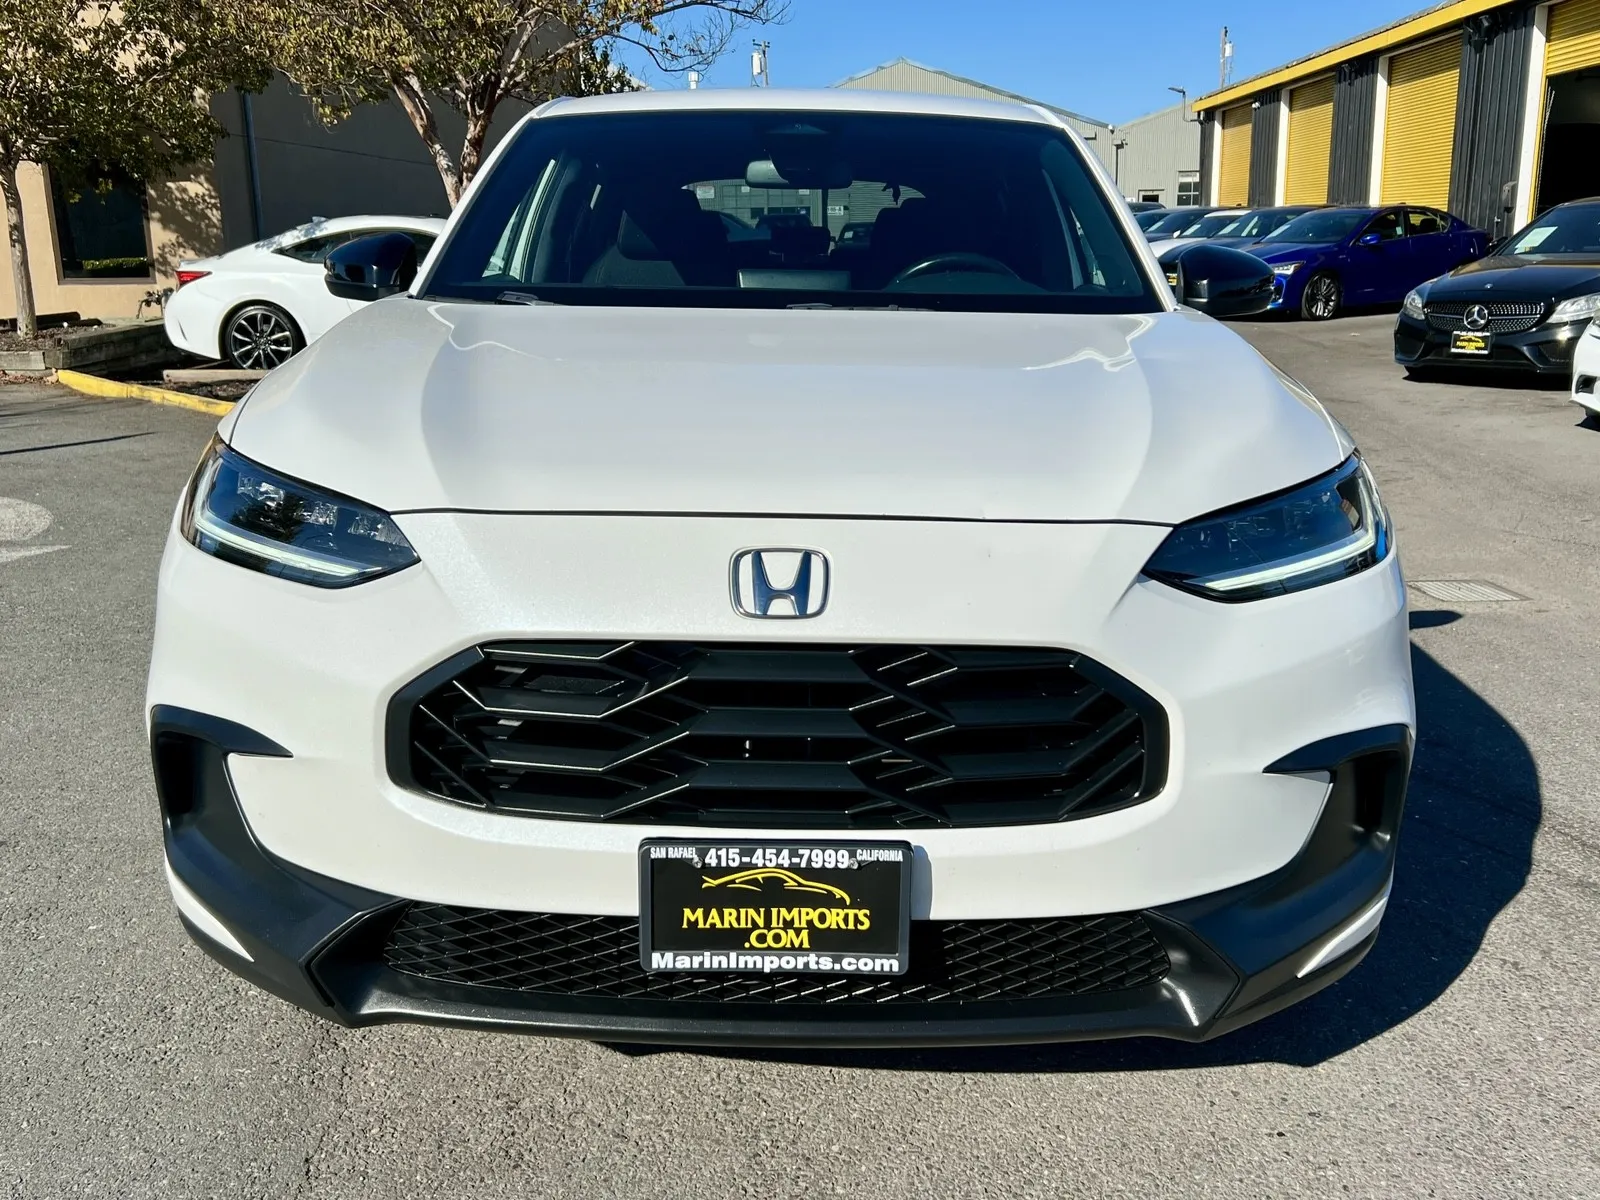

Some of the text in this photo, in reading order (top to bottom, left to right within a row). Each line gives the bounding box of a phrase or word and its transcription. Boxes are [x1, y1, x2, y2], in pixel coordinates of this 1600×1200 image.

[650, 847, 698, 858] SAN RAFAEL
[704, 848, 849, 868] 415-454-7999
[856, 849, 903, 861] CALIFORNIA
[682, 908, 871, 930] MARIN IMPORTS
[744, 929, 810, 949] .COM
[651, 952, 899, 972] MarinImports.com
